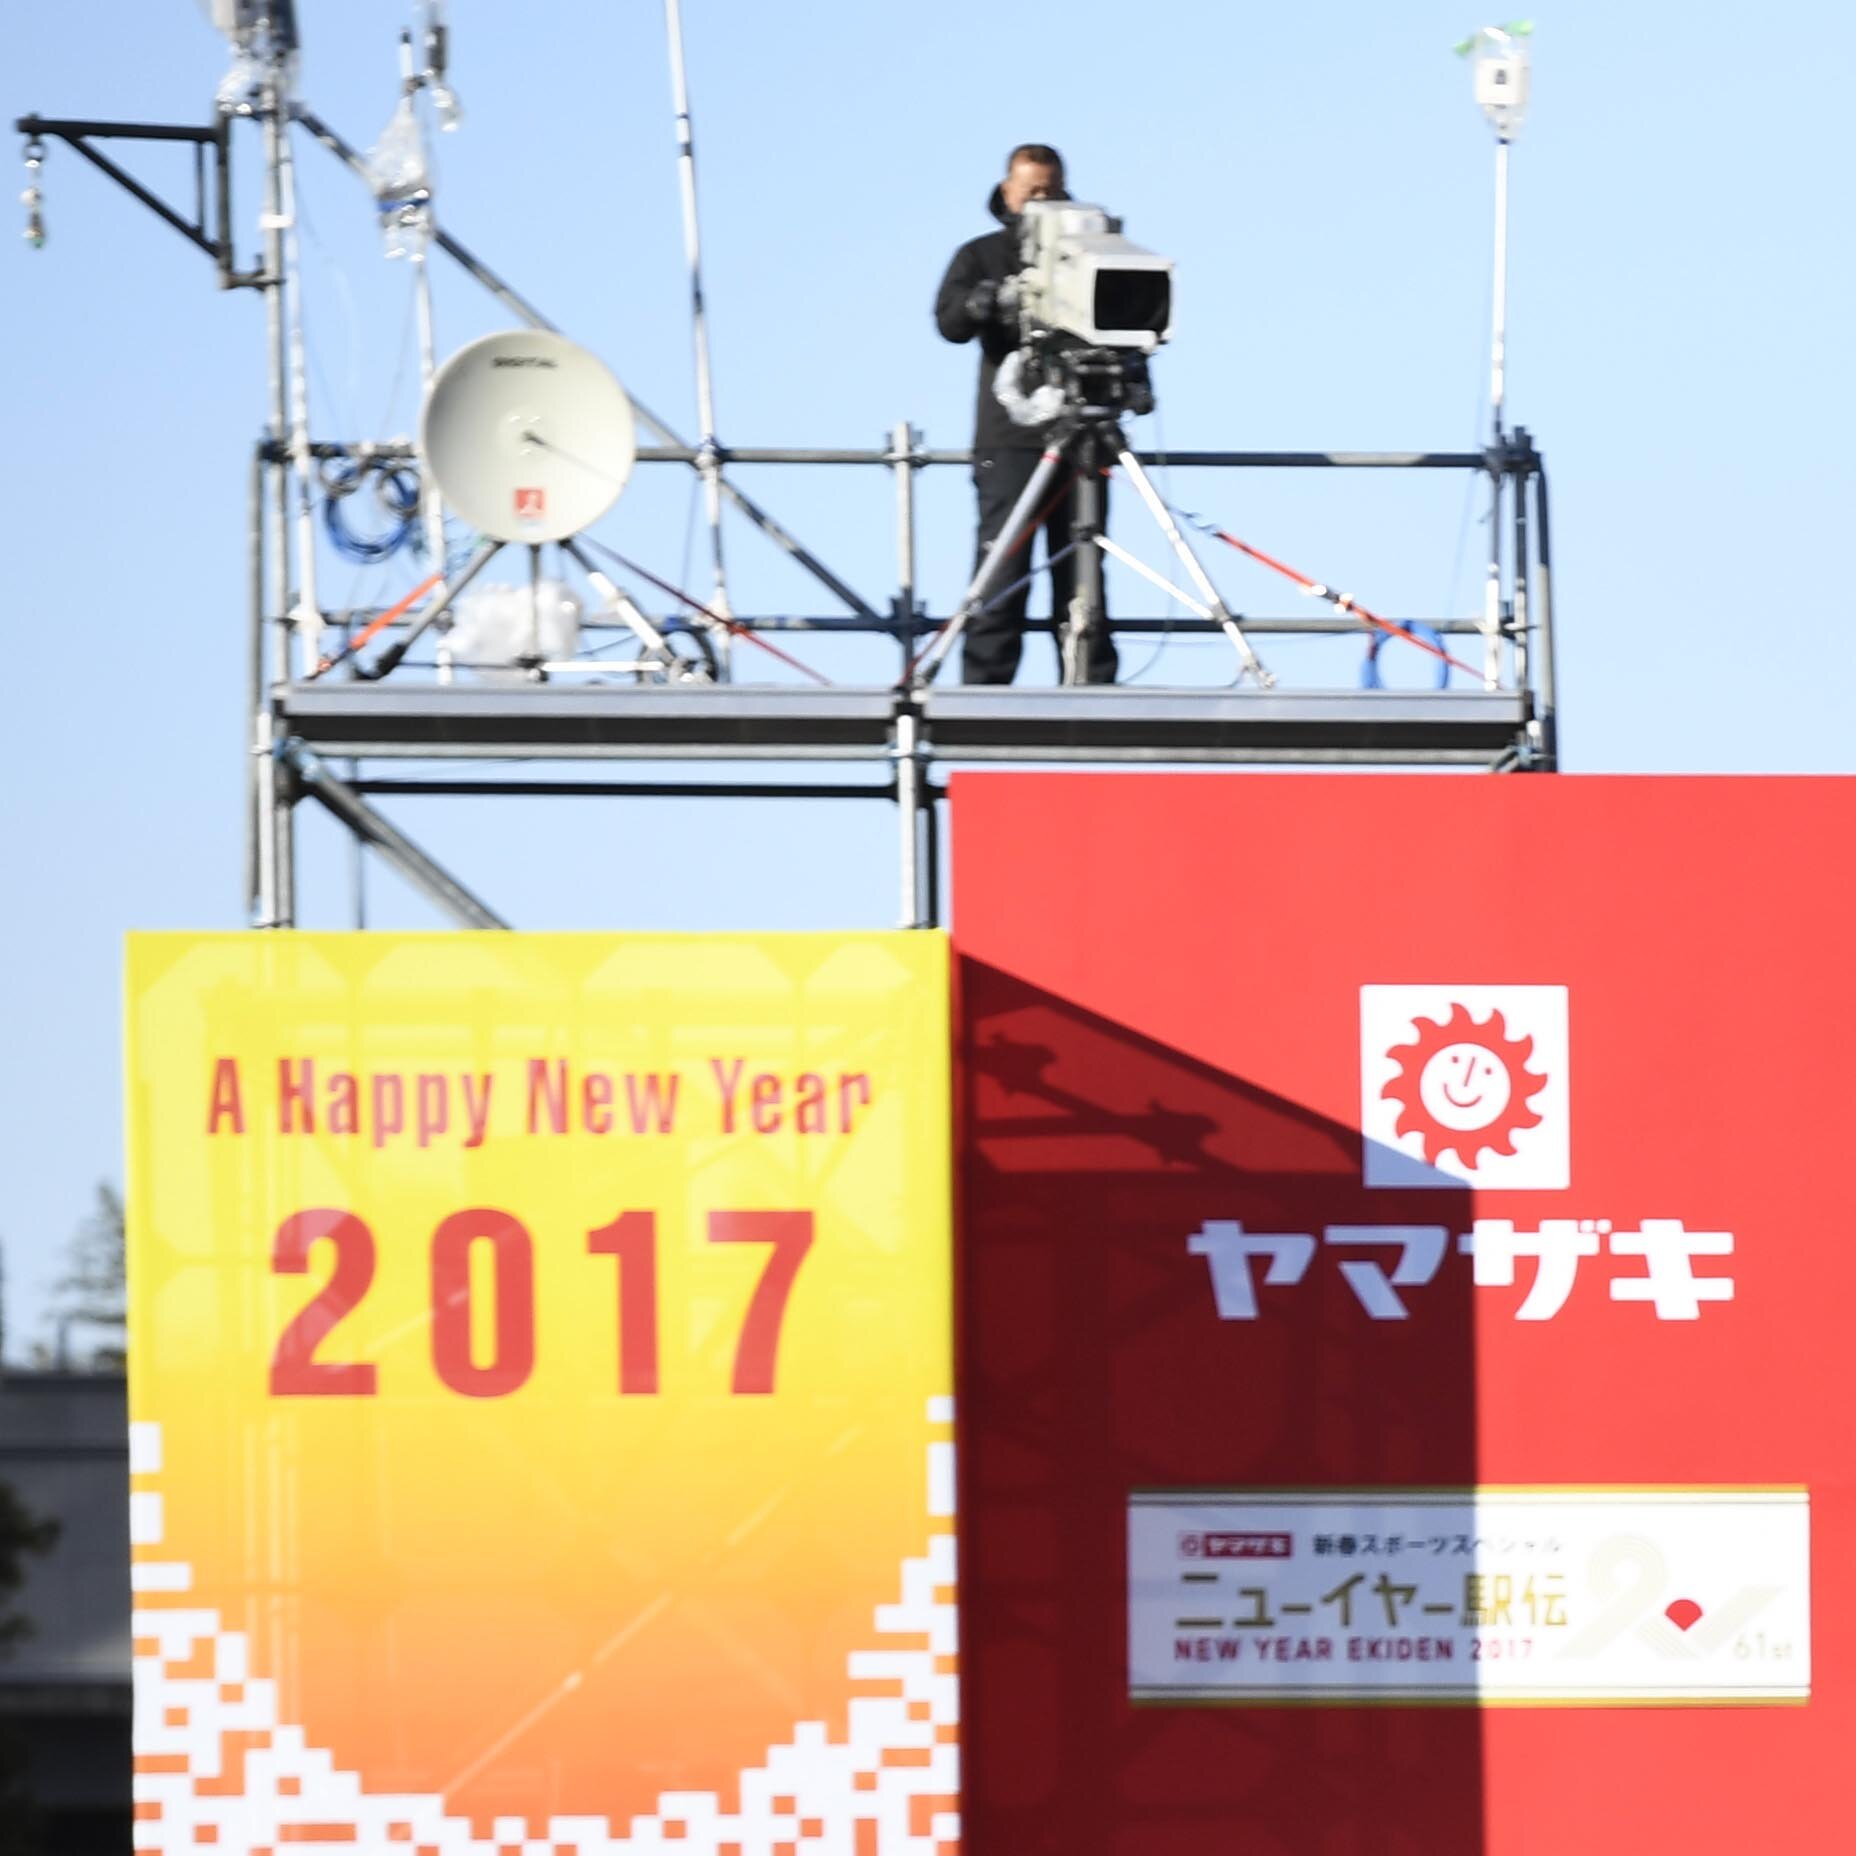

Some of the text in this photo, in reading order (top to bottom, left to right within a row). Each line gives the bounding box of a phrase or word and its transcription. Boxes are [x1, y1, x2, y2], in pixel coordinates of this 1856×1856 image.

[206, 1058, 873, 1149] A Happy New Year
[268, 1207, 816, 1397] 2017
[1187, 1219, 1735, 1320] ヤマザキ
[1175, 1572, 1568, 1629] ニューイヤー駅伝
[1175, 1638, 1533, 1662] NEW YEAR EKIDEN 2017
